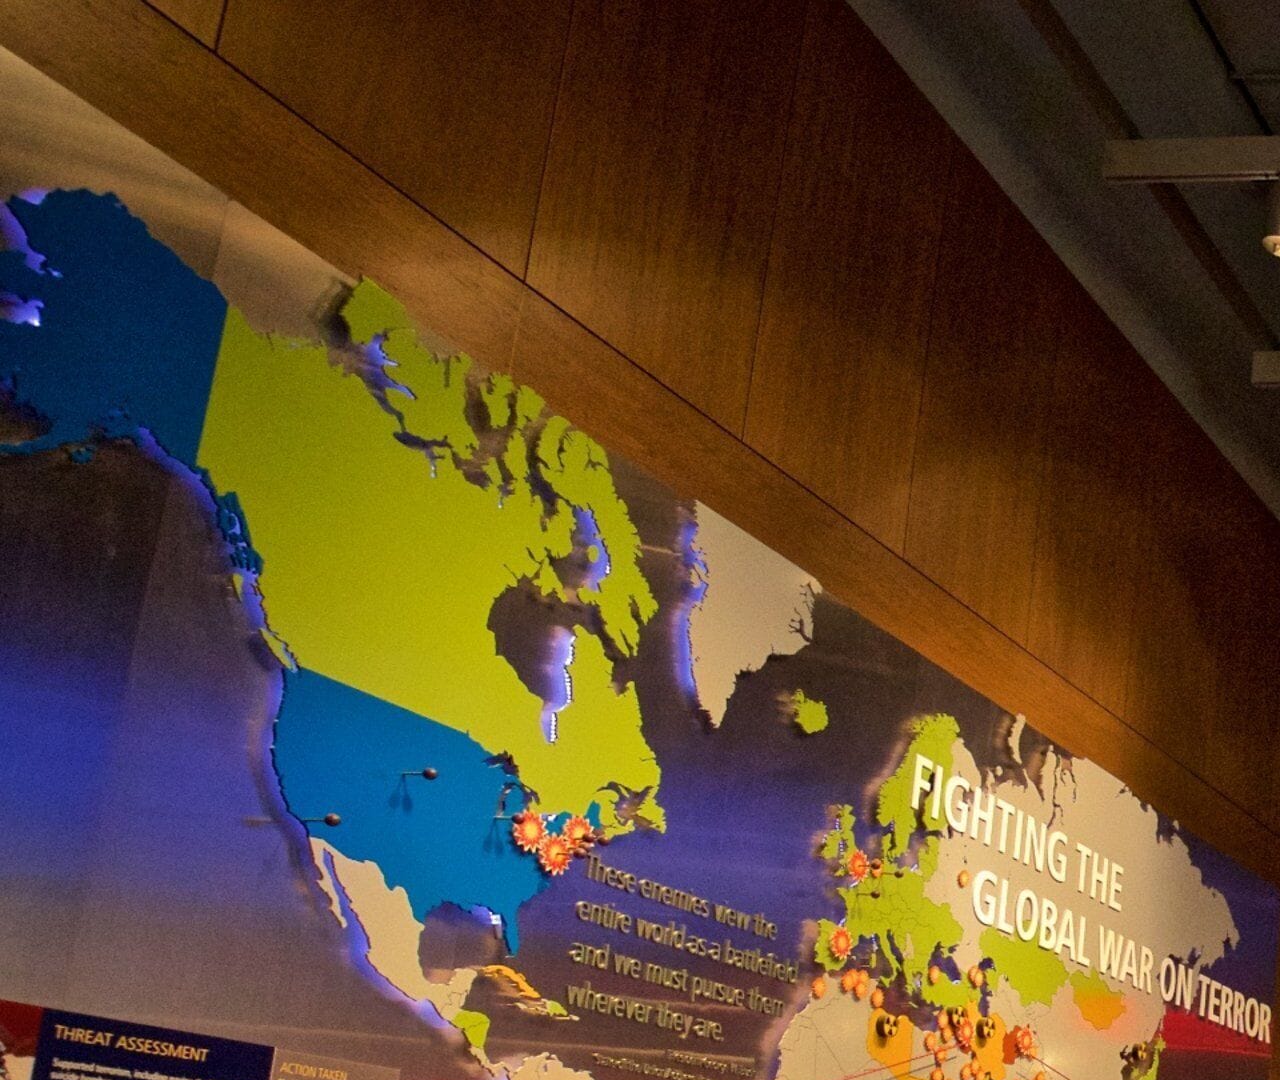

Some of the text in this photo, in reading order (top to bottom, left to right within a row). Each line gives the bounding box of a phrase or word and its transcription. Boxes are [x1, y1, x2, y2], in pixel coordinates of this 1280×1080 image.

[912, 752, 1125, 912] FIGHTING THE
[586, 852, 778, 940] These enemies view the
[568, 942, 786, 1018] and we must pursue them
[576, 900, 800, 984] entire world as a battlefield
[972, 870, 1272, 1044] GLOBAL WAR ON TERROR
[53, 1024, 209, 1062] THREAT ASSESSMENT
[566, 980, 725, 1042] wherever they are.
[280, 1061, 317, 1078] ACTION
